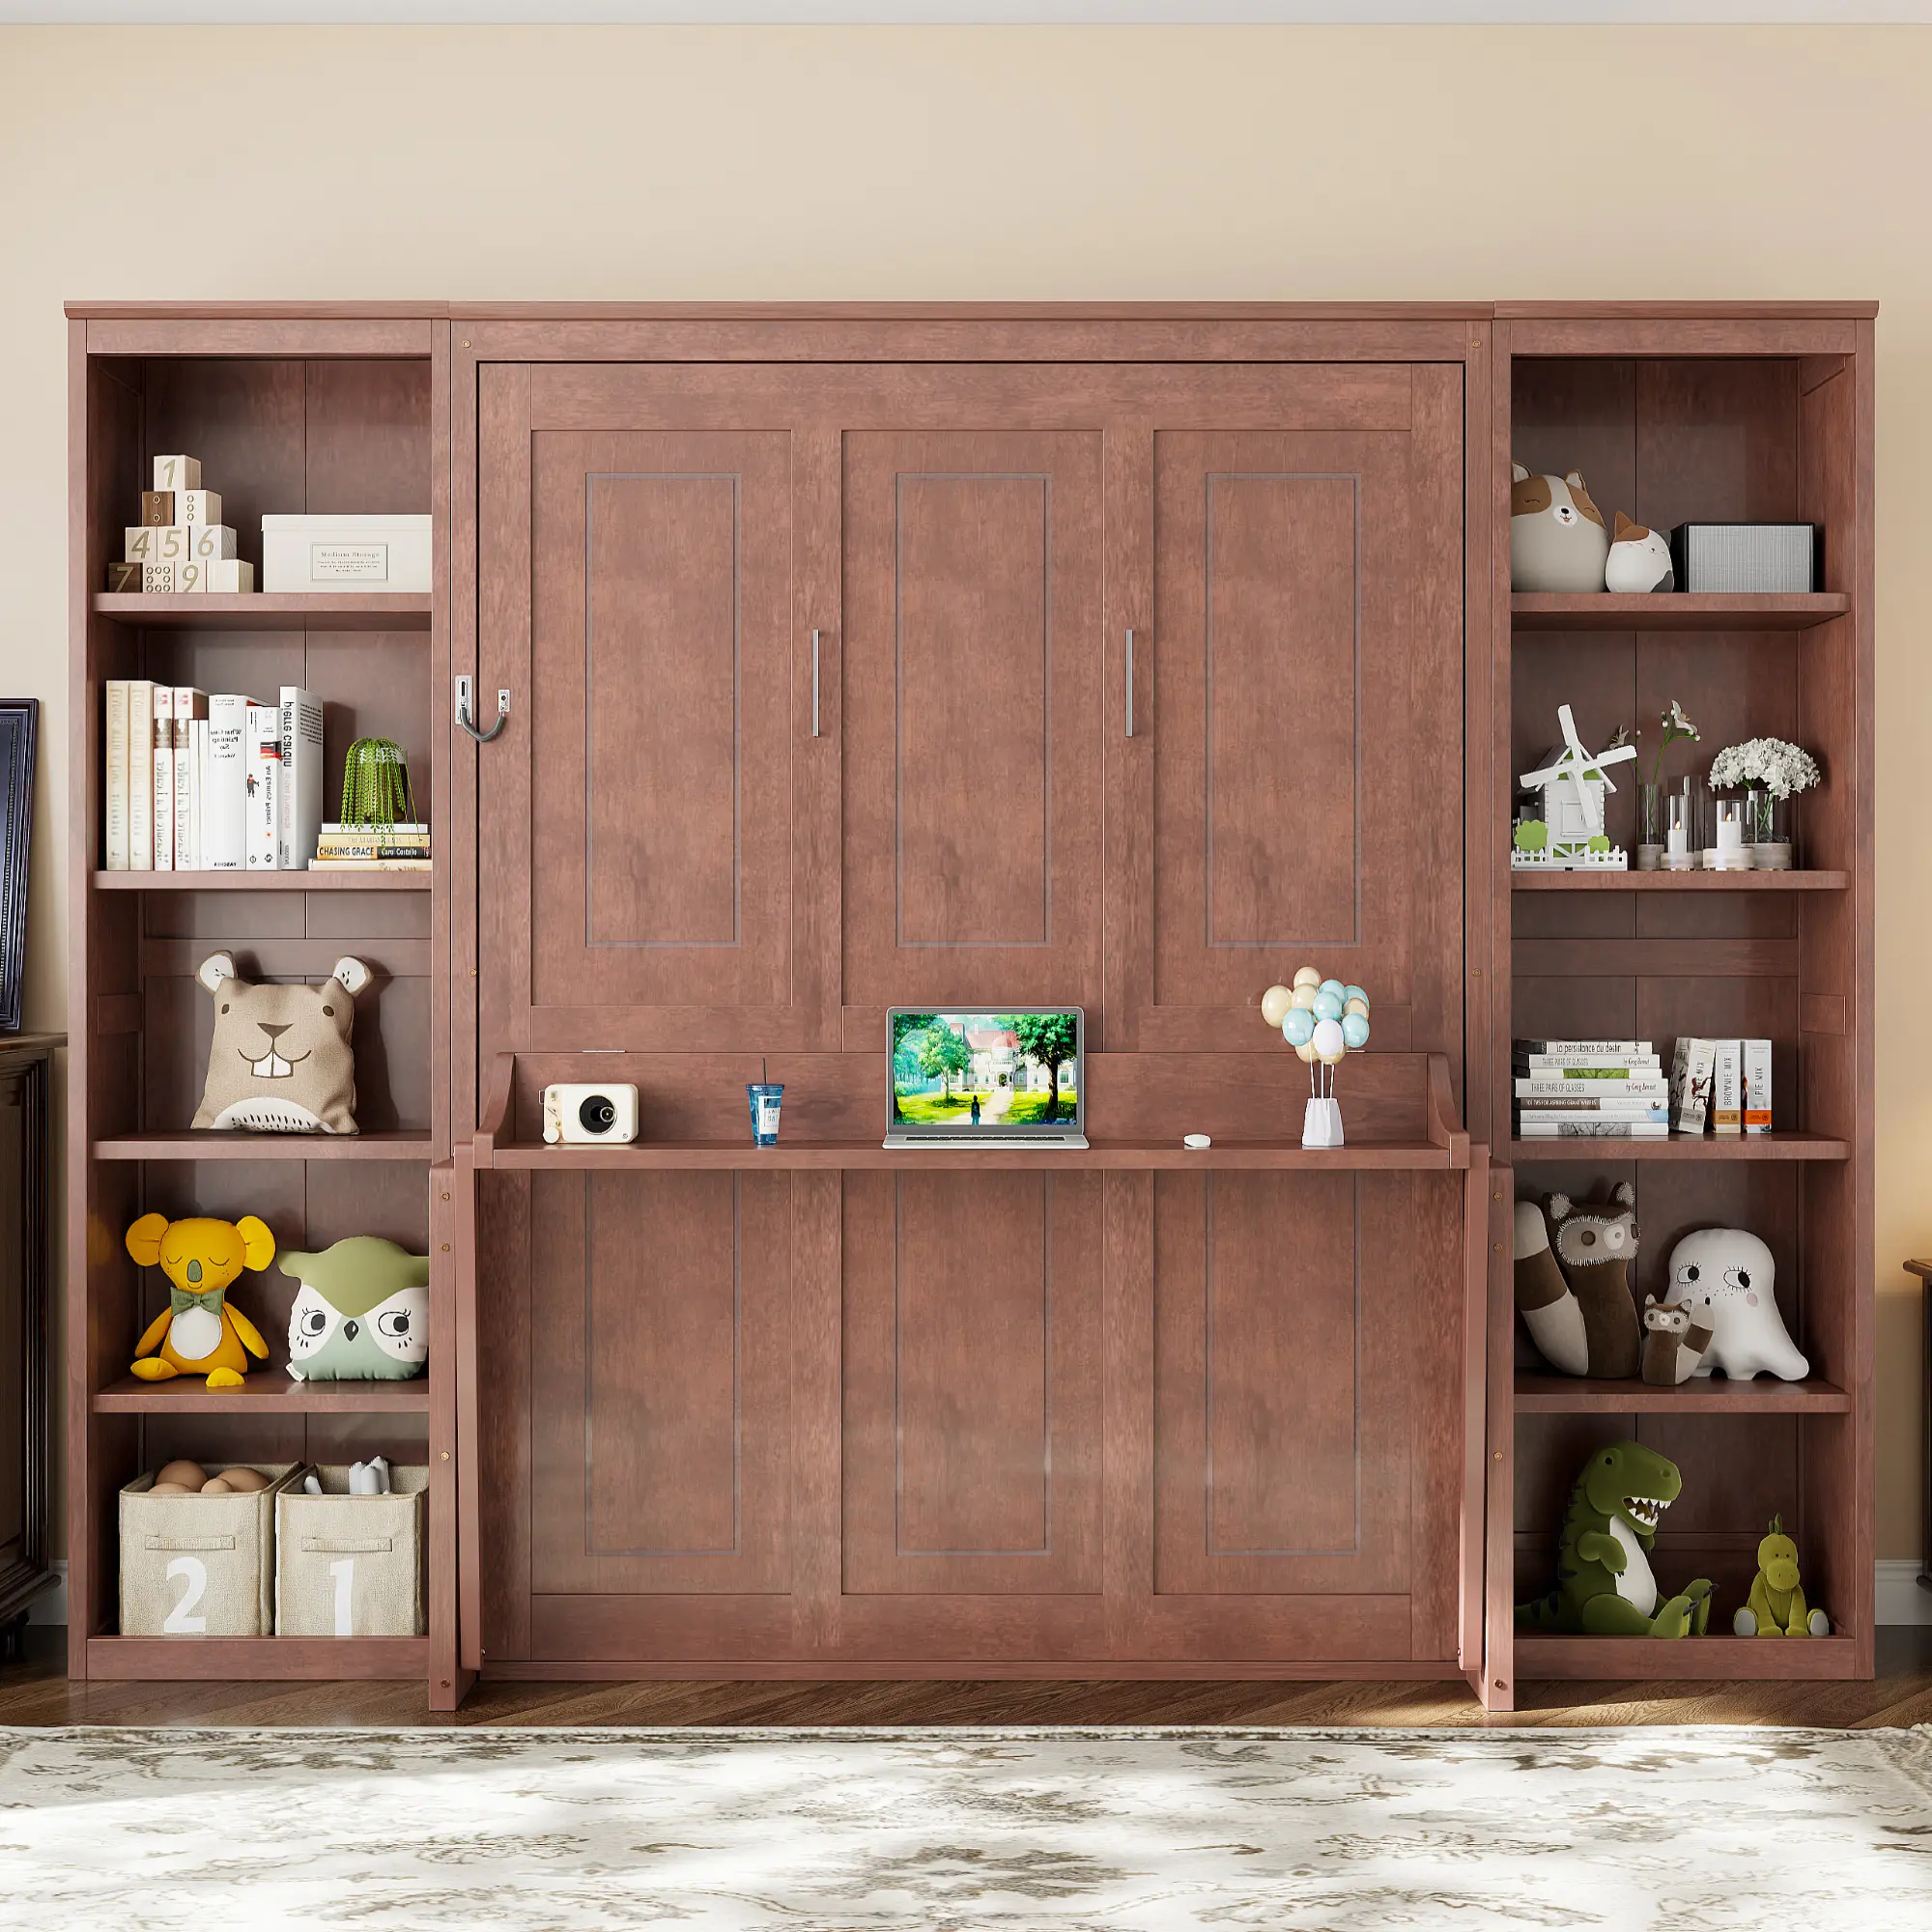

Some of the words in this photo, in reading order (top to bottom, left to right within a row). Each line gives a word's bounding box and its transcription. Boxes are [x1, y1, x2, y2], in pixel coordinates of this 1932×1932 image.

[162, 459, 176, 488] 1
[131, 530, 151, 559] 4
[163, 529, 183, 558] 5
[197, 528, 214, 557] 6
[116, 566, 134, 592] 7
[182, 564, 199, 593] 9
[319, 846, 350, 856] CHASING
[352, 846, 375, 856] GRACE
[1723, 1057, 1732, 1070] MIX
[1723, 1074, 1732, 1106] BROWNIE
[163, 1556, 207, 1633] 2
[329, 1558, 354, 1635] 1
